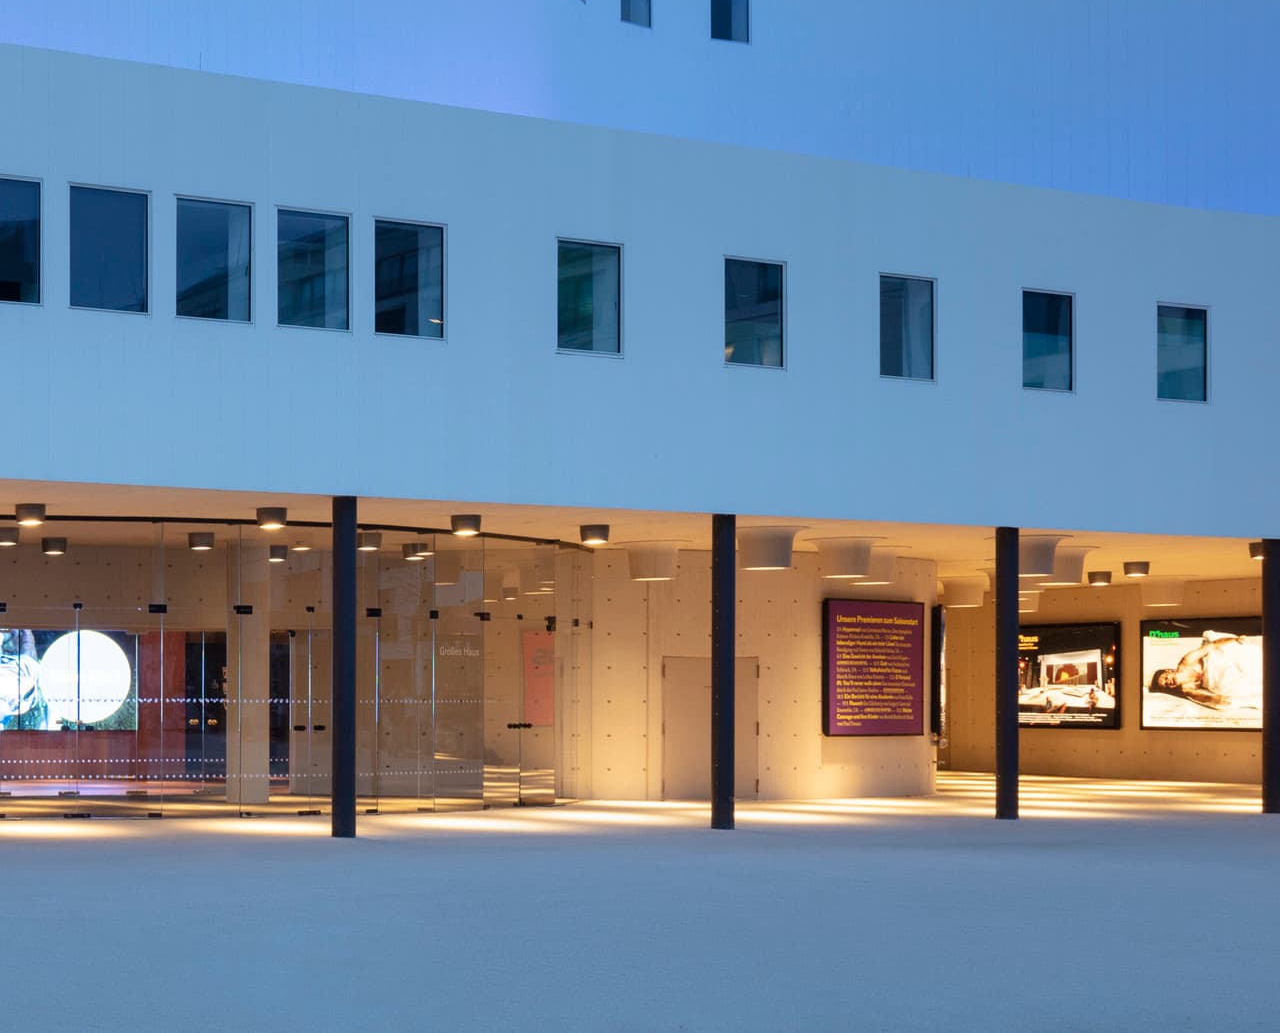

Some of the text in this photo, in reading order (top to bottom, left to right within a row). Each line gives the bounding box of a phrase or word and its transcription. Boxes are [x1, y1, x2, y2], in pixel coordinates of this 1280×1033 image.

[836, 615, 857, 623] Unsere
[857, 615, 883, 624] Premieren
[1018, 634, 1039, 643] 'haus
[1149, 630, 1180, 639] D'haus
[439, 646, 480, 656] Großes Haus
